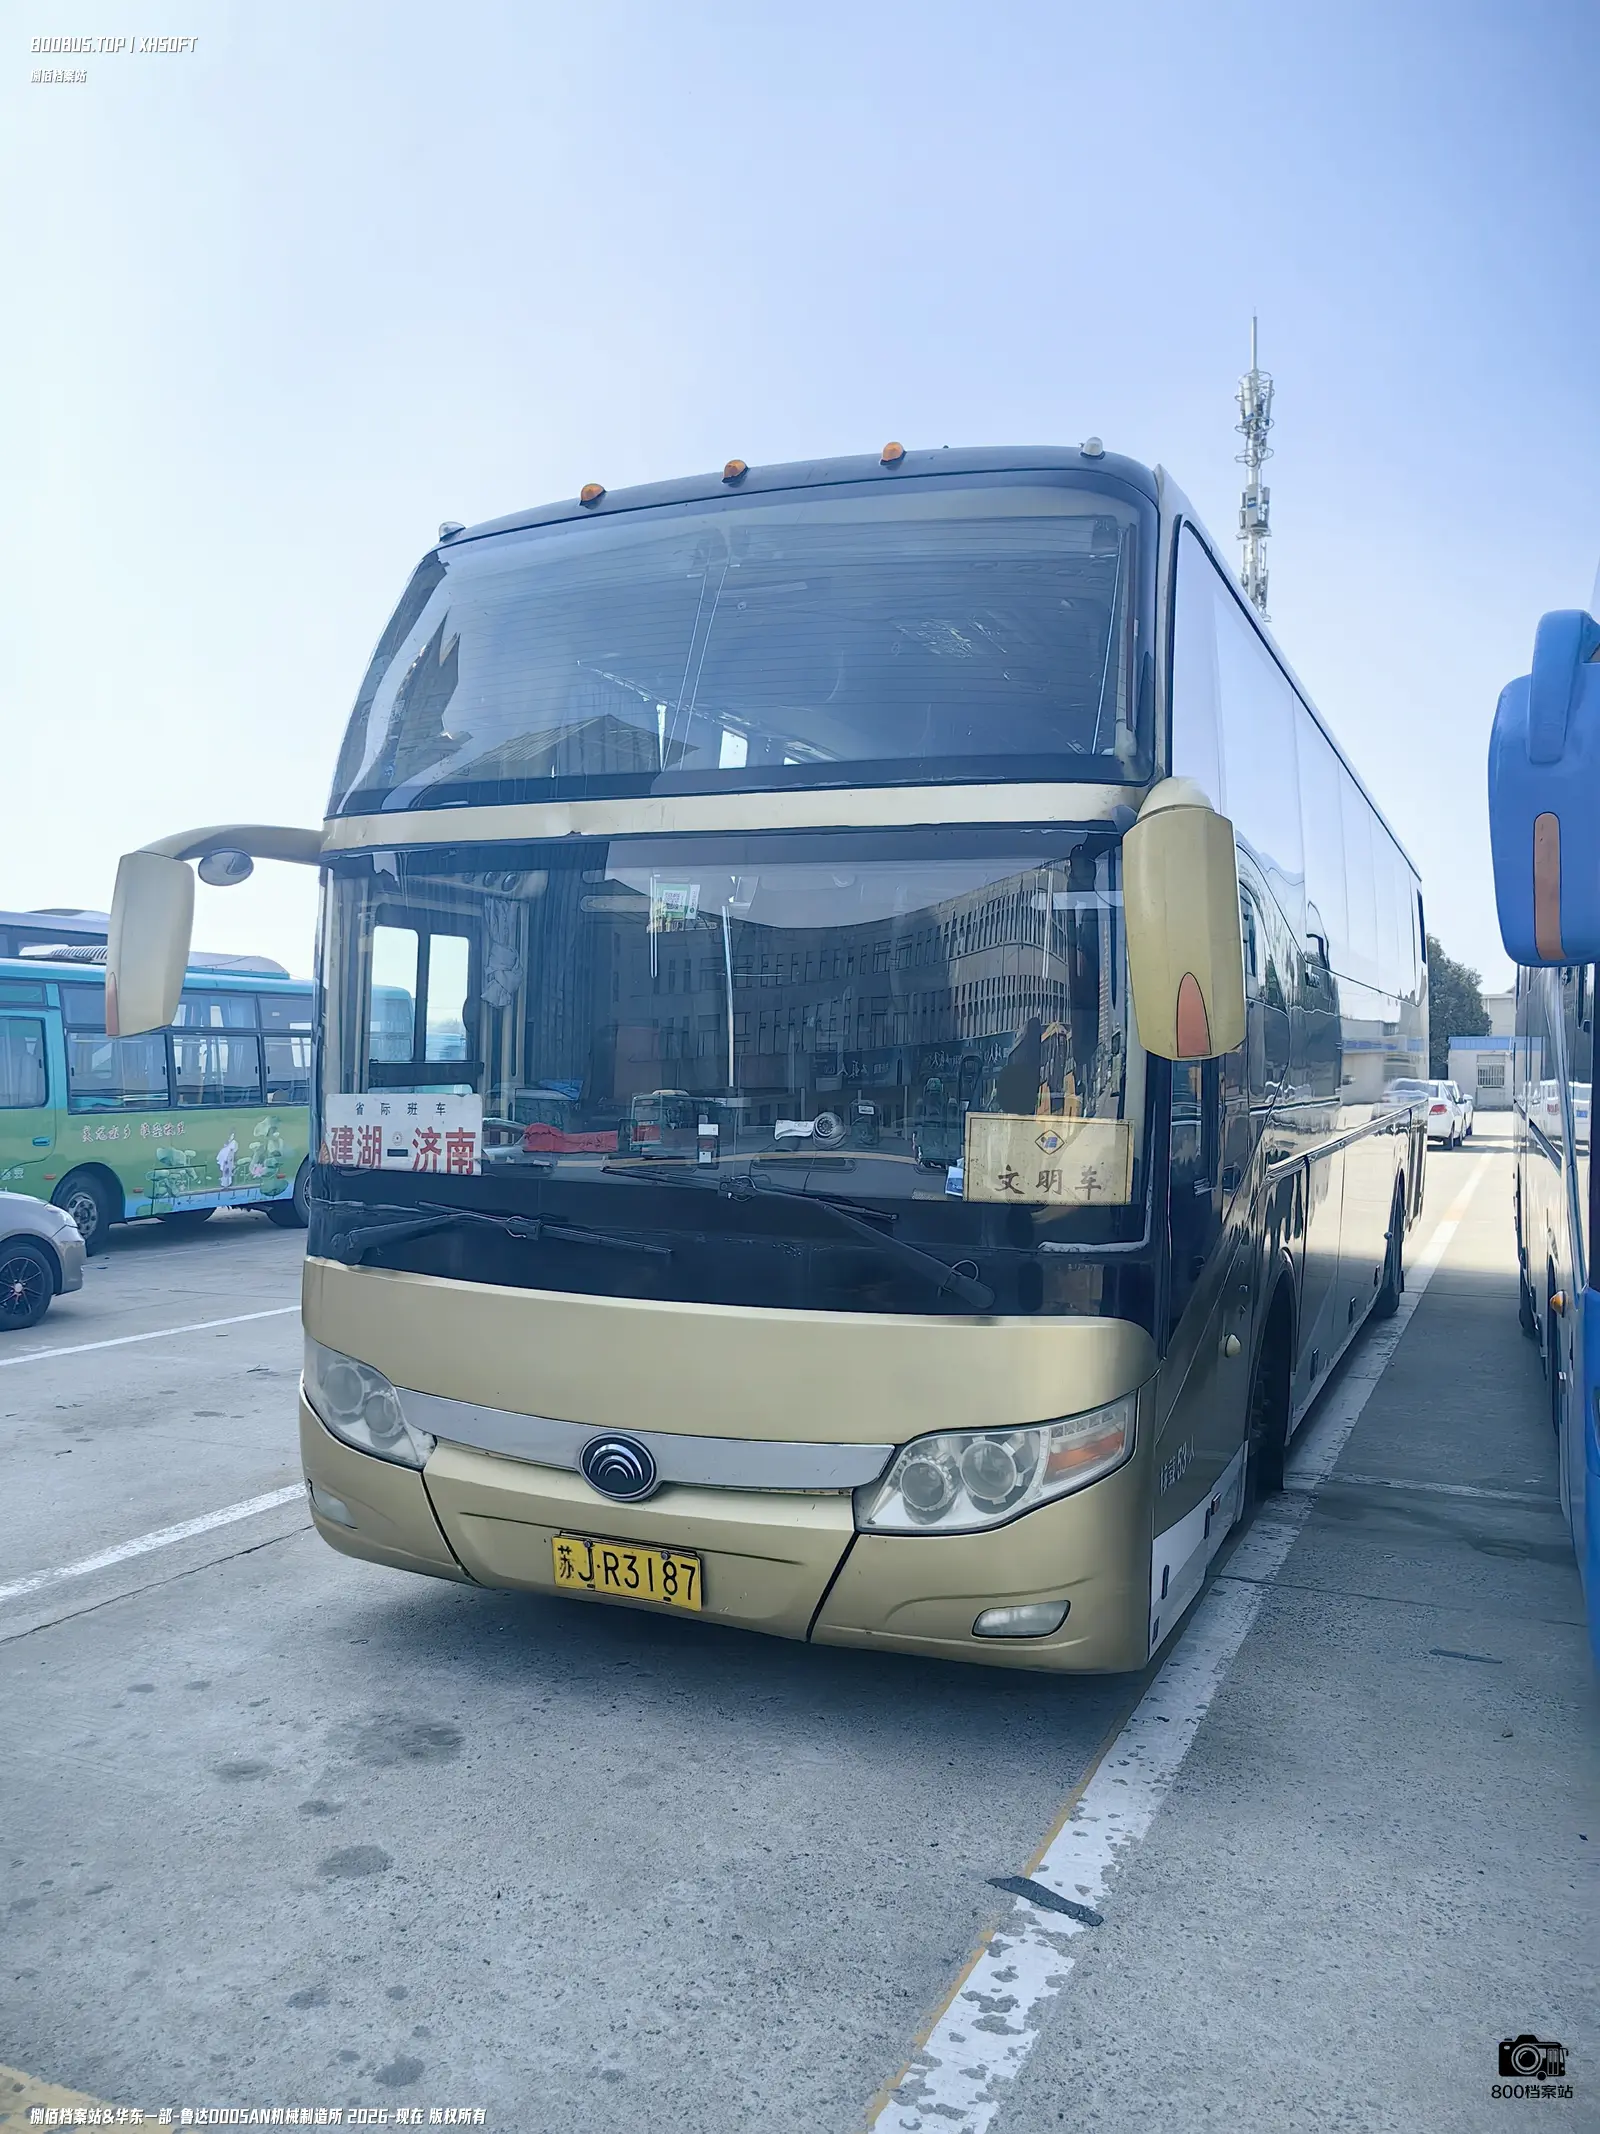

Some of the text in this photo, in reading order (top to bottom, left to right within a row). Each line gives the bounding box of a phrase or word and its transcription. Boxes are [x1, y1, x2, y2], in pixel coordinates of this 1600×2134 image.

[355, 1102, 446, 1116] 省际班车
[995, 1164, 1101, 1200] 文明车
